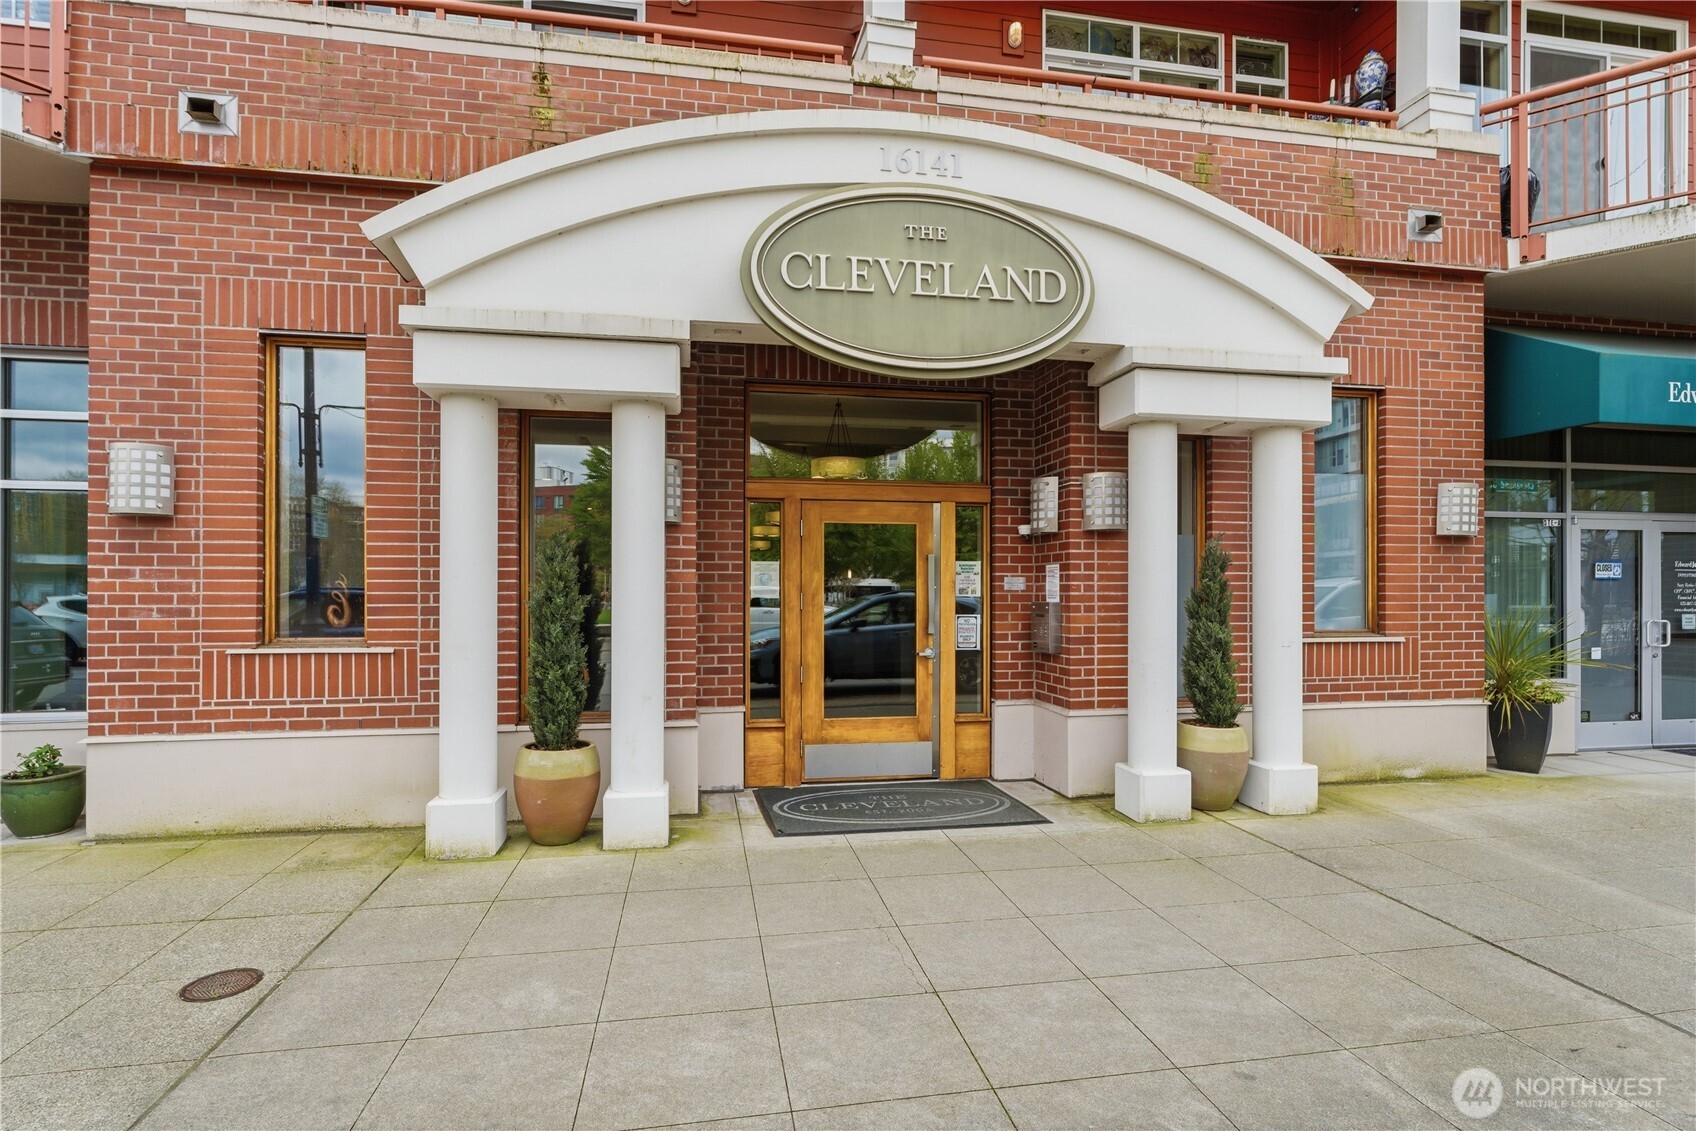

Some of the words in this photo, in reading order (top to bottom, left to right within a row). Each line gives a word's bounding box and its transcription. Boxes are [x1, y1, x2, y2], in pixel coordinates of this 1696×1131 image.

[880, 145, 963, 179] 16141
[904, 224, 948, 241] THE
[780, 251, 1067, 304] CLEVELAND
[799, 797, 985, 813] CLEVELAND
